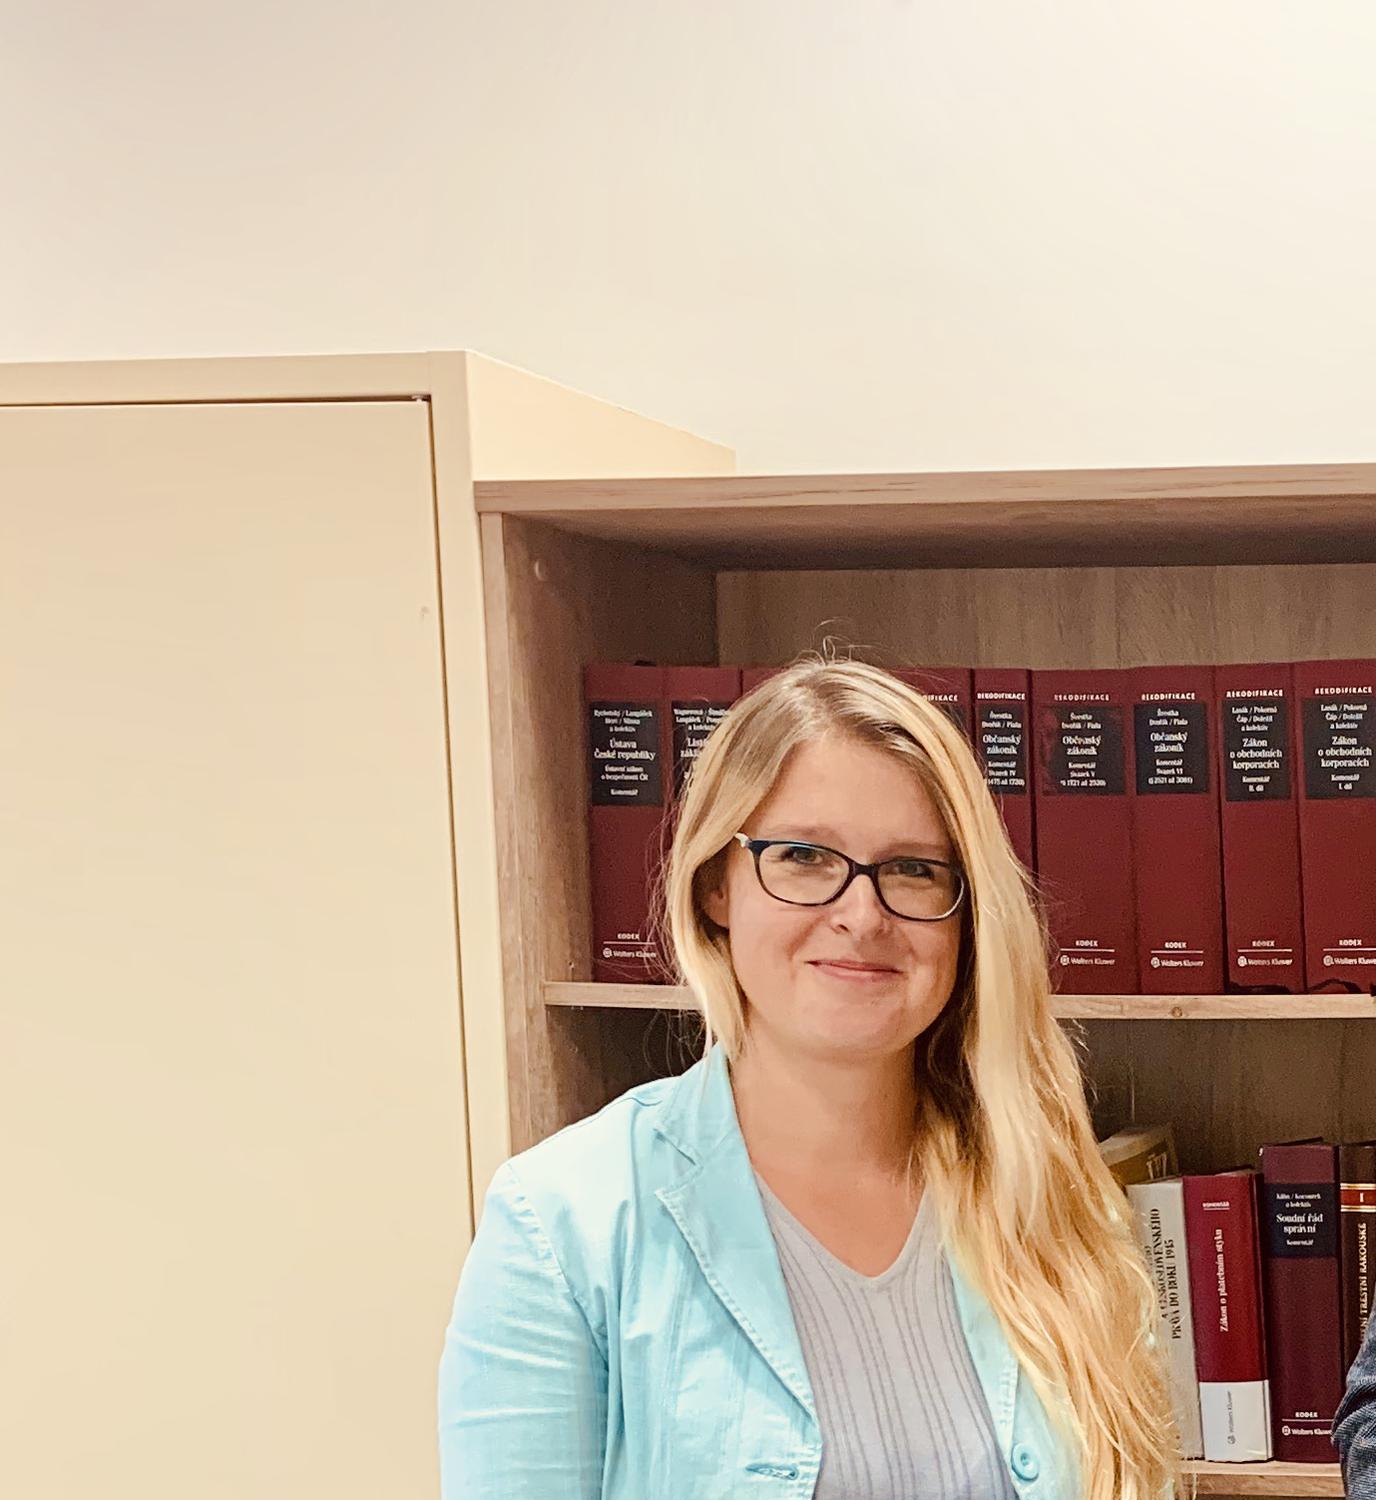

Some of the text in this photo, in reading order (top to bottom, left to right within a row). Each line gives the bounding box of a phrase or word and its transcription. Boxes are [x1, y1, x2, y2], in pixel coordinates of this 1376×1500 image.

[983, 734, 1022, 745] Občanský
[1062, 735, 1102, 746] Občanský
[1150, 732, 1188, 743] Občanský
[1242, 738, 1268, 748] Zákon
[1331, 736, 1358, 745] Zákon
[610, 738, 637, 749] Ústava
[1154, 743, 1184, 753] zákoník
[594, 748, 656, 761] České republiky
[987, 745, 1018, 755] zákoník
[1067, 746, 1098, 756] zákoník
[1237, 748, 1282, 758] obchodních
[1325, 746, 1372, 756] obchodních
[1233, 760, 1280, 771] korporacích
[1321, 758, 1369, 769] korporacích
[1276, 1213, 1323, 1223] Soudní řád
[1283, 1224, 1316, 1234] správní
[1214, 1229, 1225, 1252] styku
[1358, 1223, 1367, 1273] RAKOUSKÉ
[1167, 1264, 1178, 1289] ROKU
[1216, 1254, 1228, 1296] platebním
[1169, 1293, 1179, 1306] DO
[1358, 1276, 1368, 1313] TRESTNÍ
[1218, 1305, 1229, 1332] Zákon
